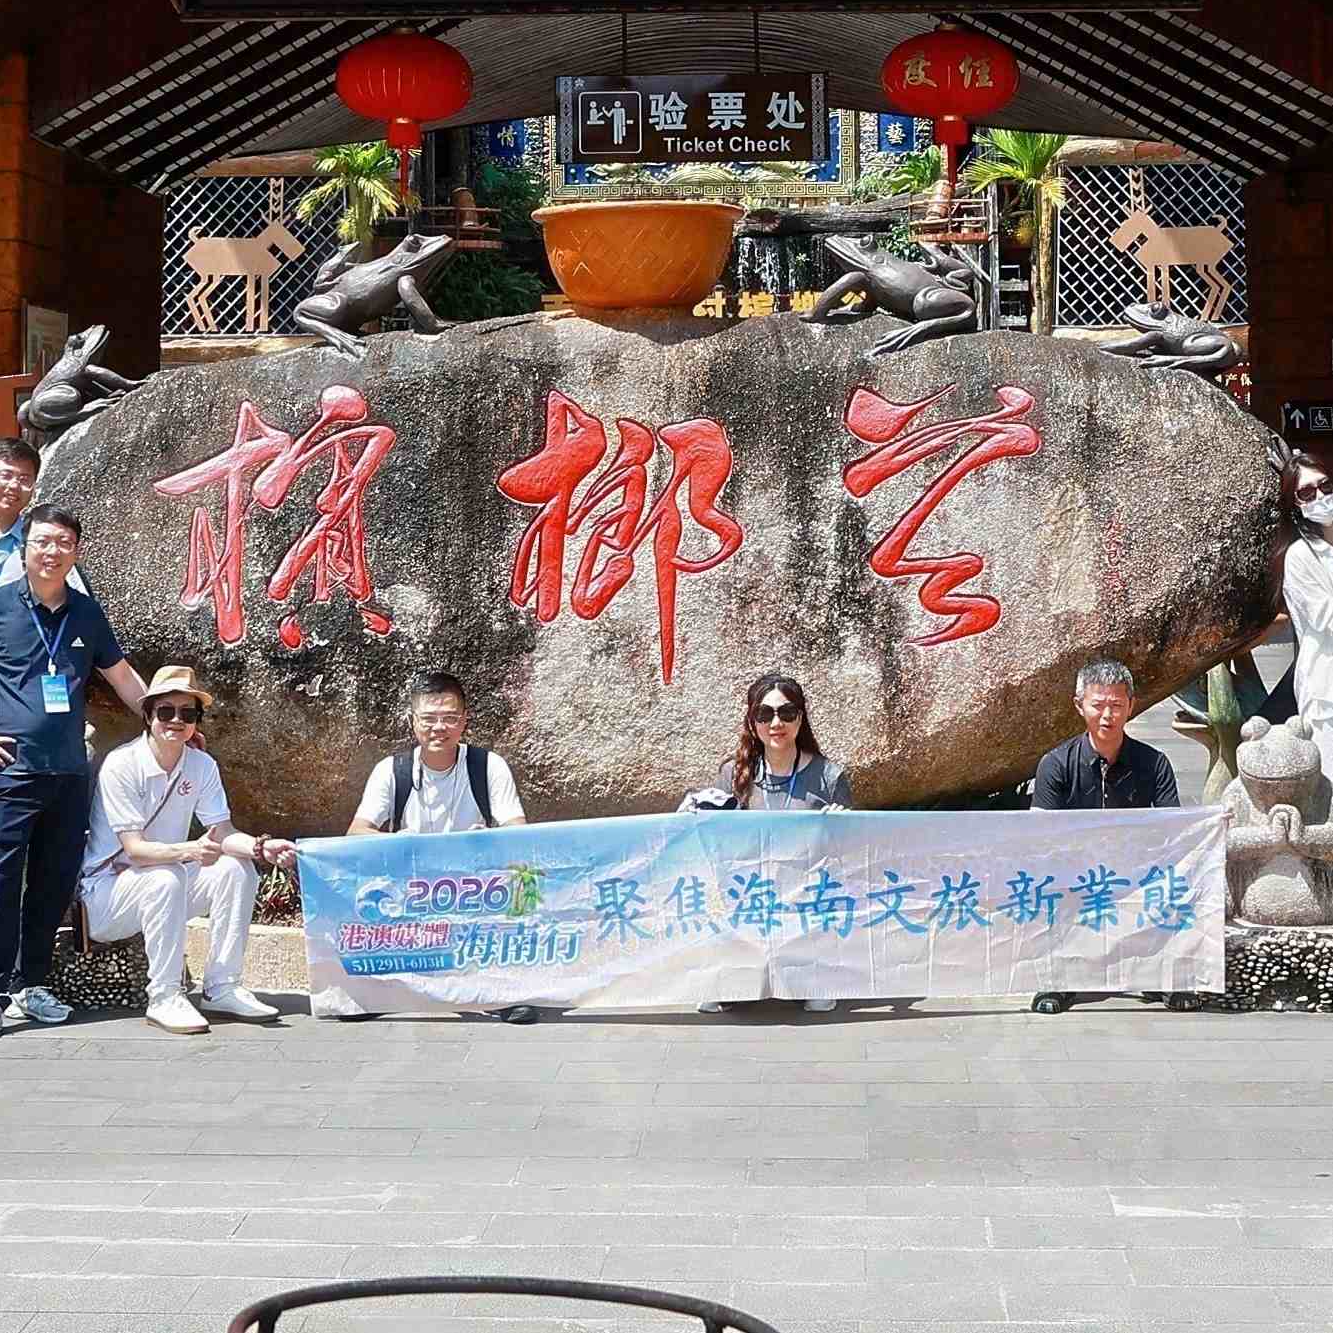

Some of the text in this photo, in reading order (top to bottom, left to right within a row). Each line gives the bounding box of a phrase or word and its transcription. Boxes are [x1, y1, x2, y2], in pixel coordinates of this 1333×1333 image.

[648, 91, 806, 132] 验票处
[662, 135, 791, 154] Ticket Check
[153, 382, 1042, 686] 槟榔谷
[403, 875, 511, 916] 2026
[593, 864, 1198, 940] 聚焦海南文旅新業態
[339, 920, 582, 969] 港澳媒體 海南行
